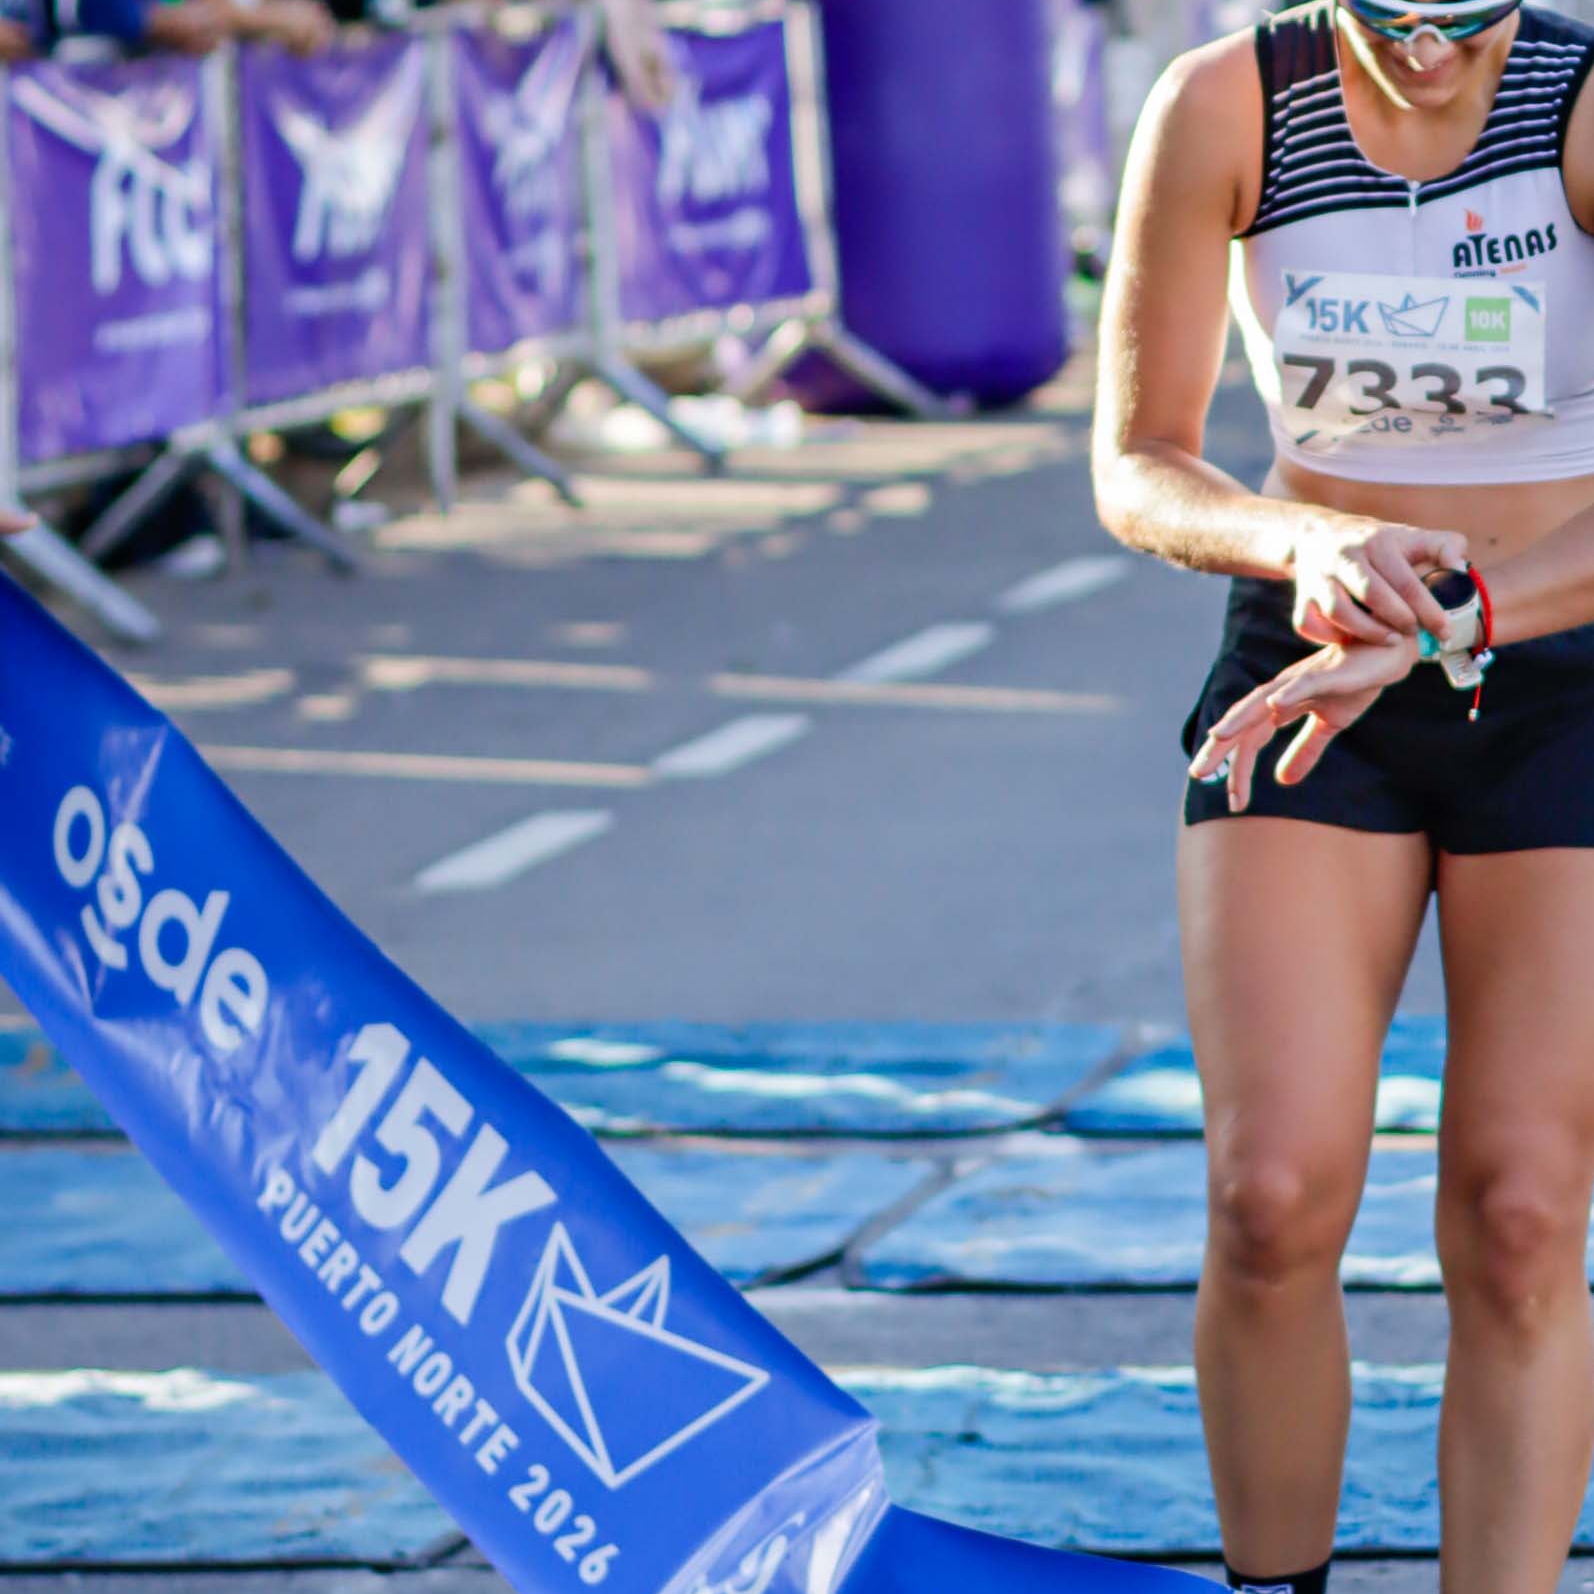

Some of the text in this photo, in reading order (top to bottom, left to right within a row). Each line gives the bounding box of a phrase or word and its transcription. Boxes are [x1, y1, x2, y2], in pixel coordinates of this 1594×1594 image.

[1305, 297, 1371, 334] 15K
[1452, 222, 1557, 267] ATENAS
[1282, 352, 1532, 415] 7333
[53, 784, 268, 1053] osde
[312, 1022, 558, 1328] 15K
[257, 1164, 620, 1585] PUERTO NORTE 2026
